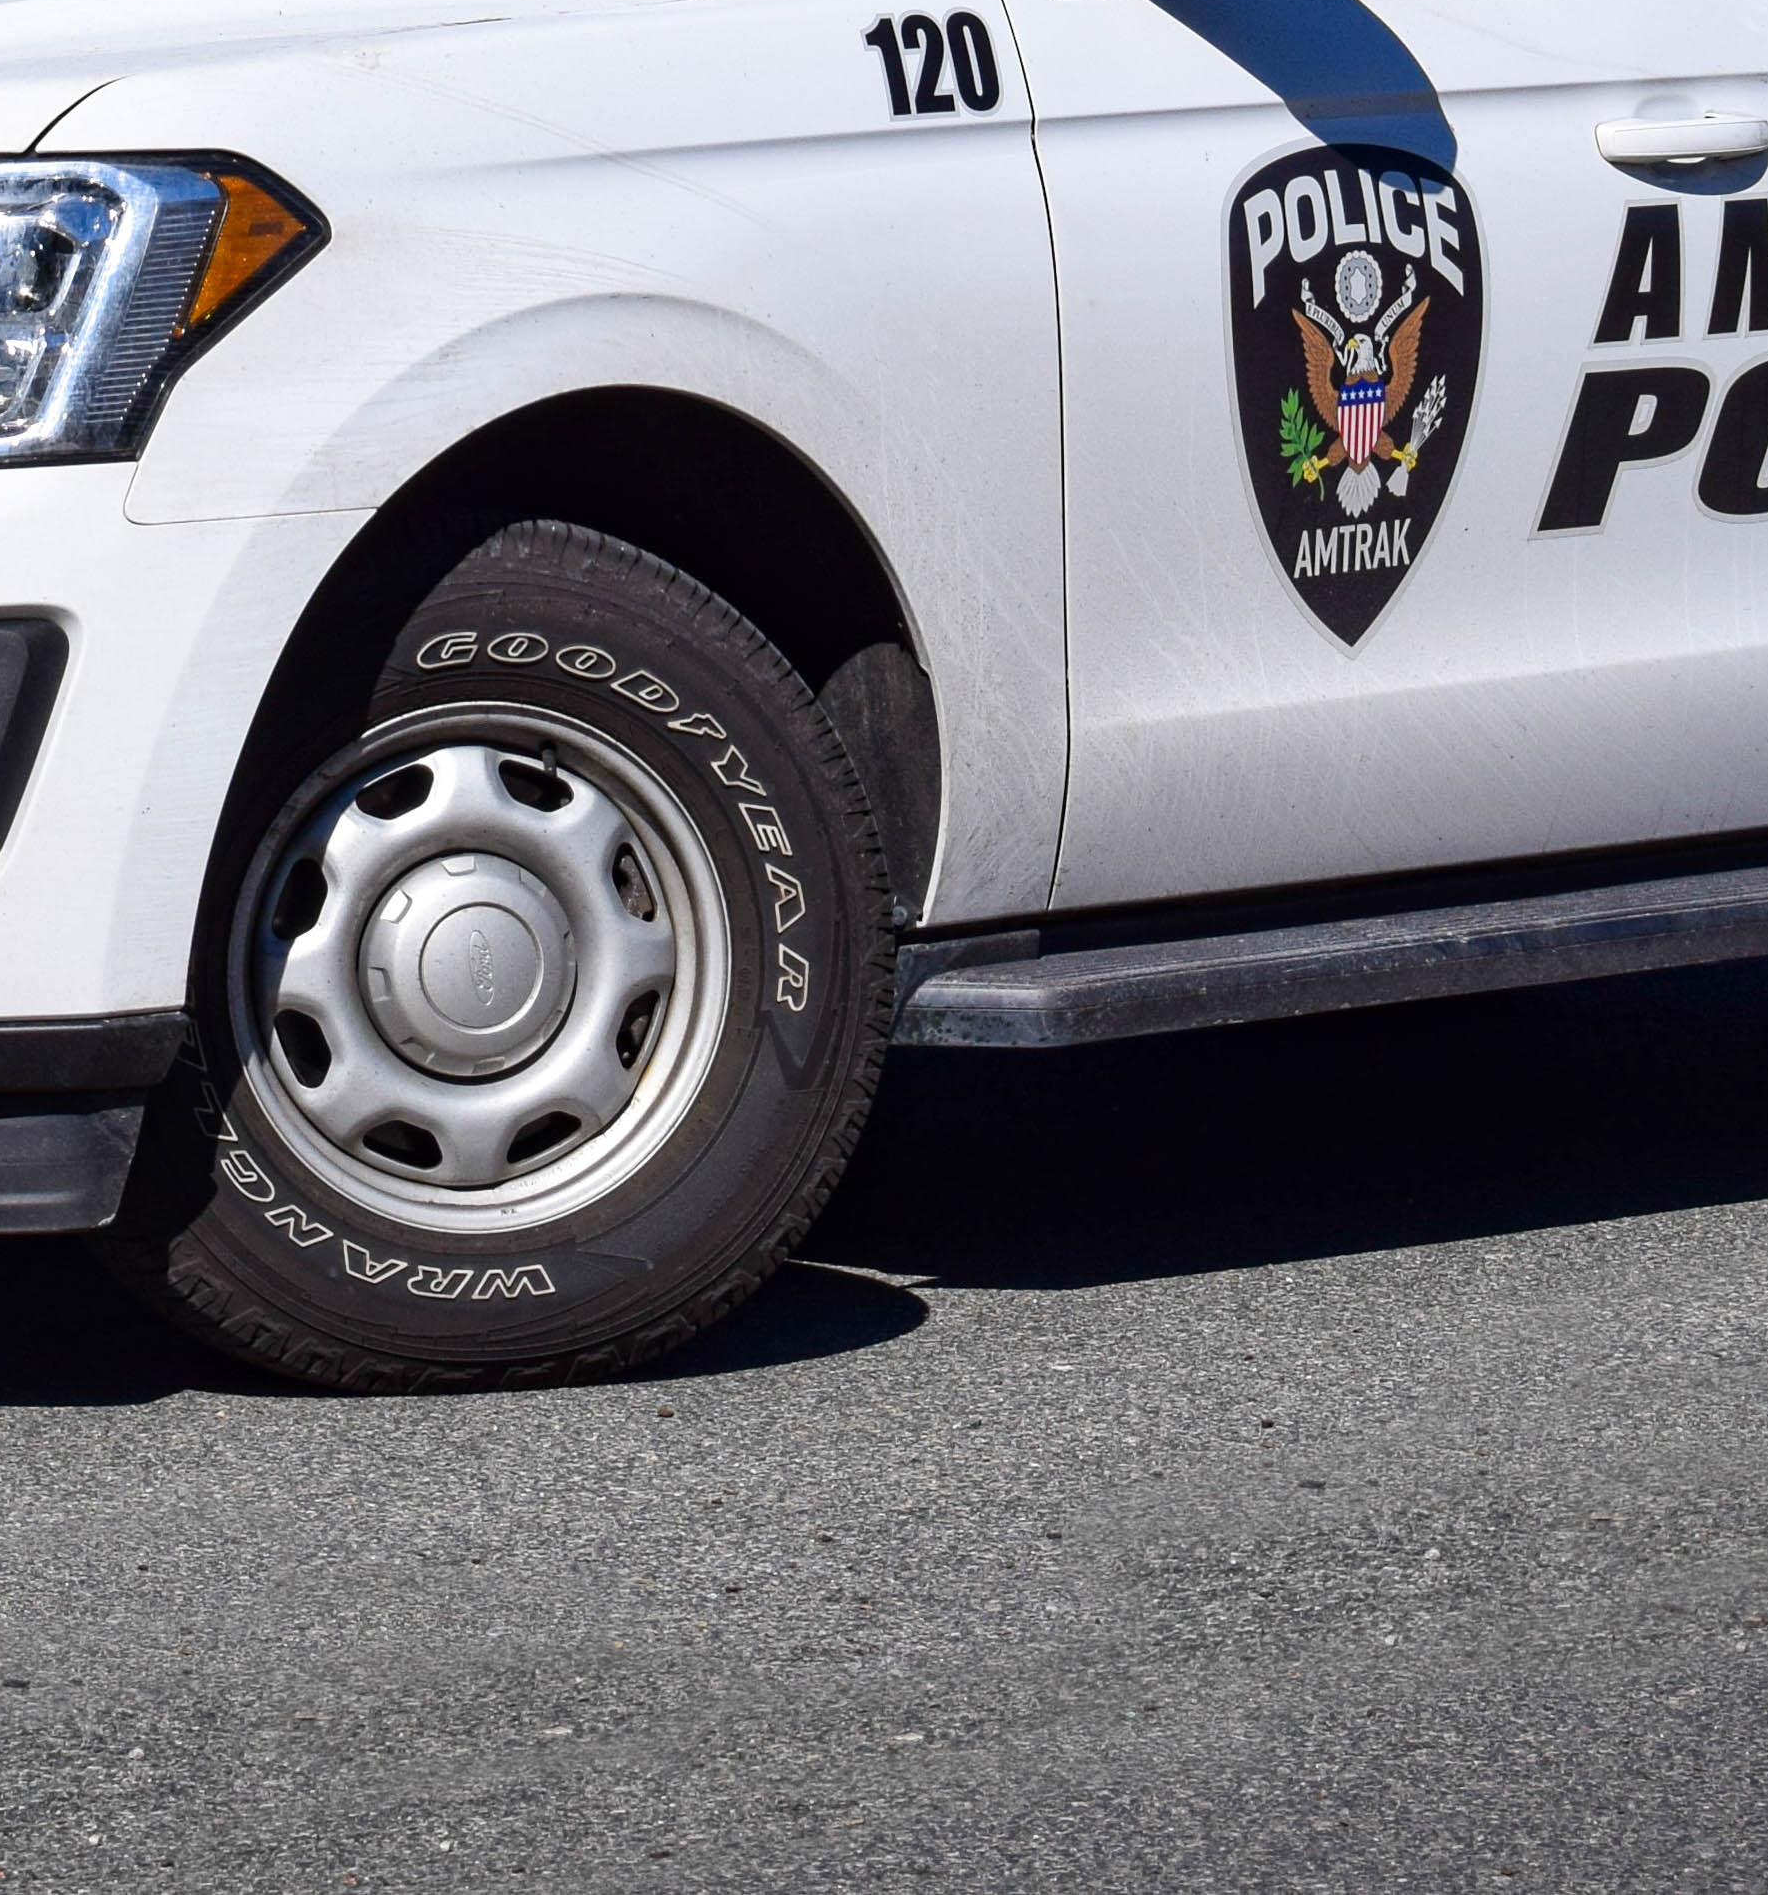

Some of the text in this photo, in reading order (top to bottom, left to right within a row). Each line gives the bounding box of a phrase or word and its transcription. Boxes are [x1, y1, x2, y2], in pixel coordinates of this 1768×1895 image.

[864, 10, 1000, 116] 120
[1243, 168, 1465, 310] POLICE
[1381, 300, 1405, 328] UNUM
[1293, 517, 1412, 579] AMTRAK
[417, 631, 811, 1013] GOODYEAR
